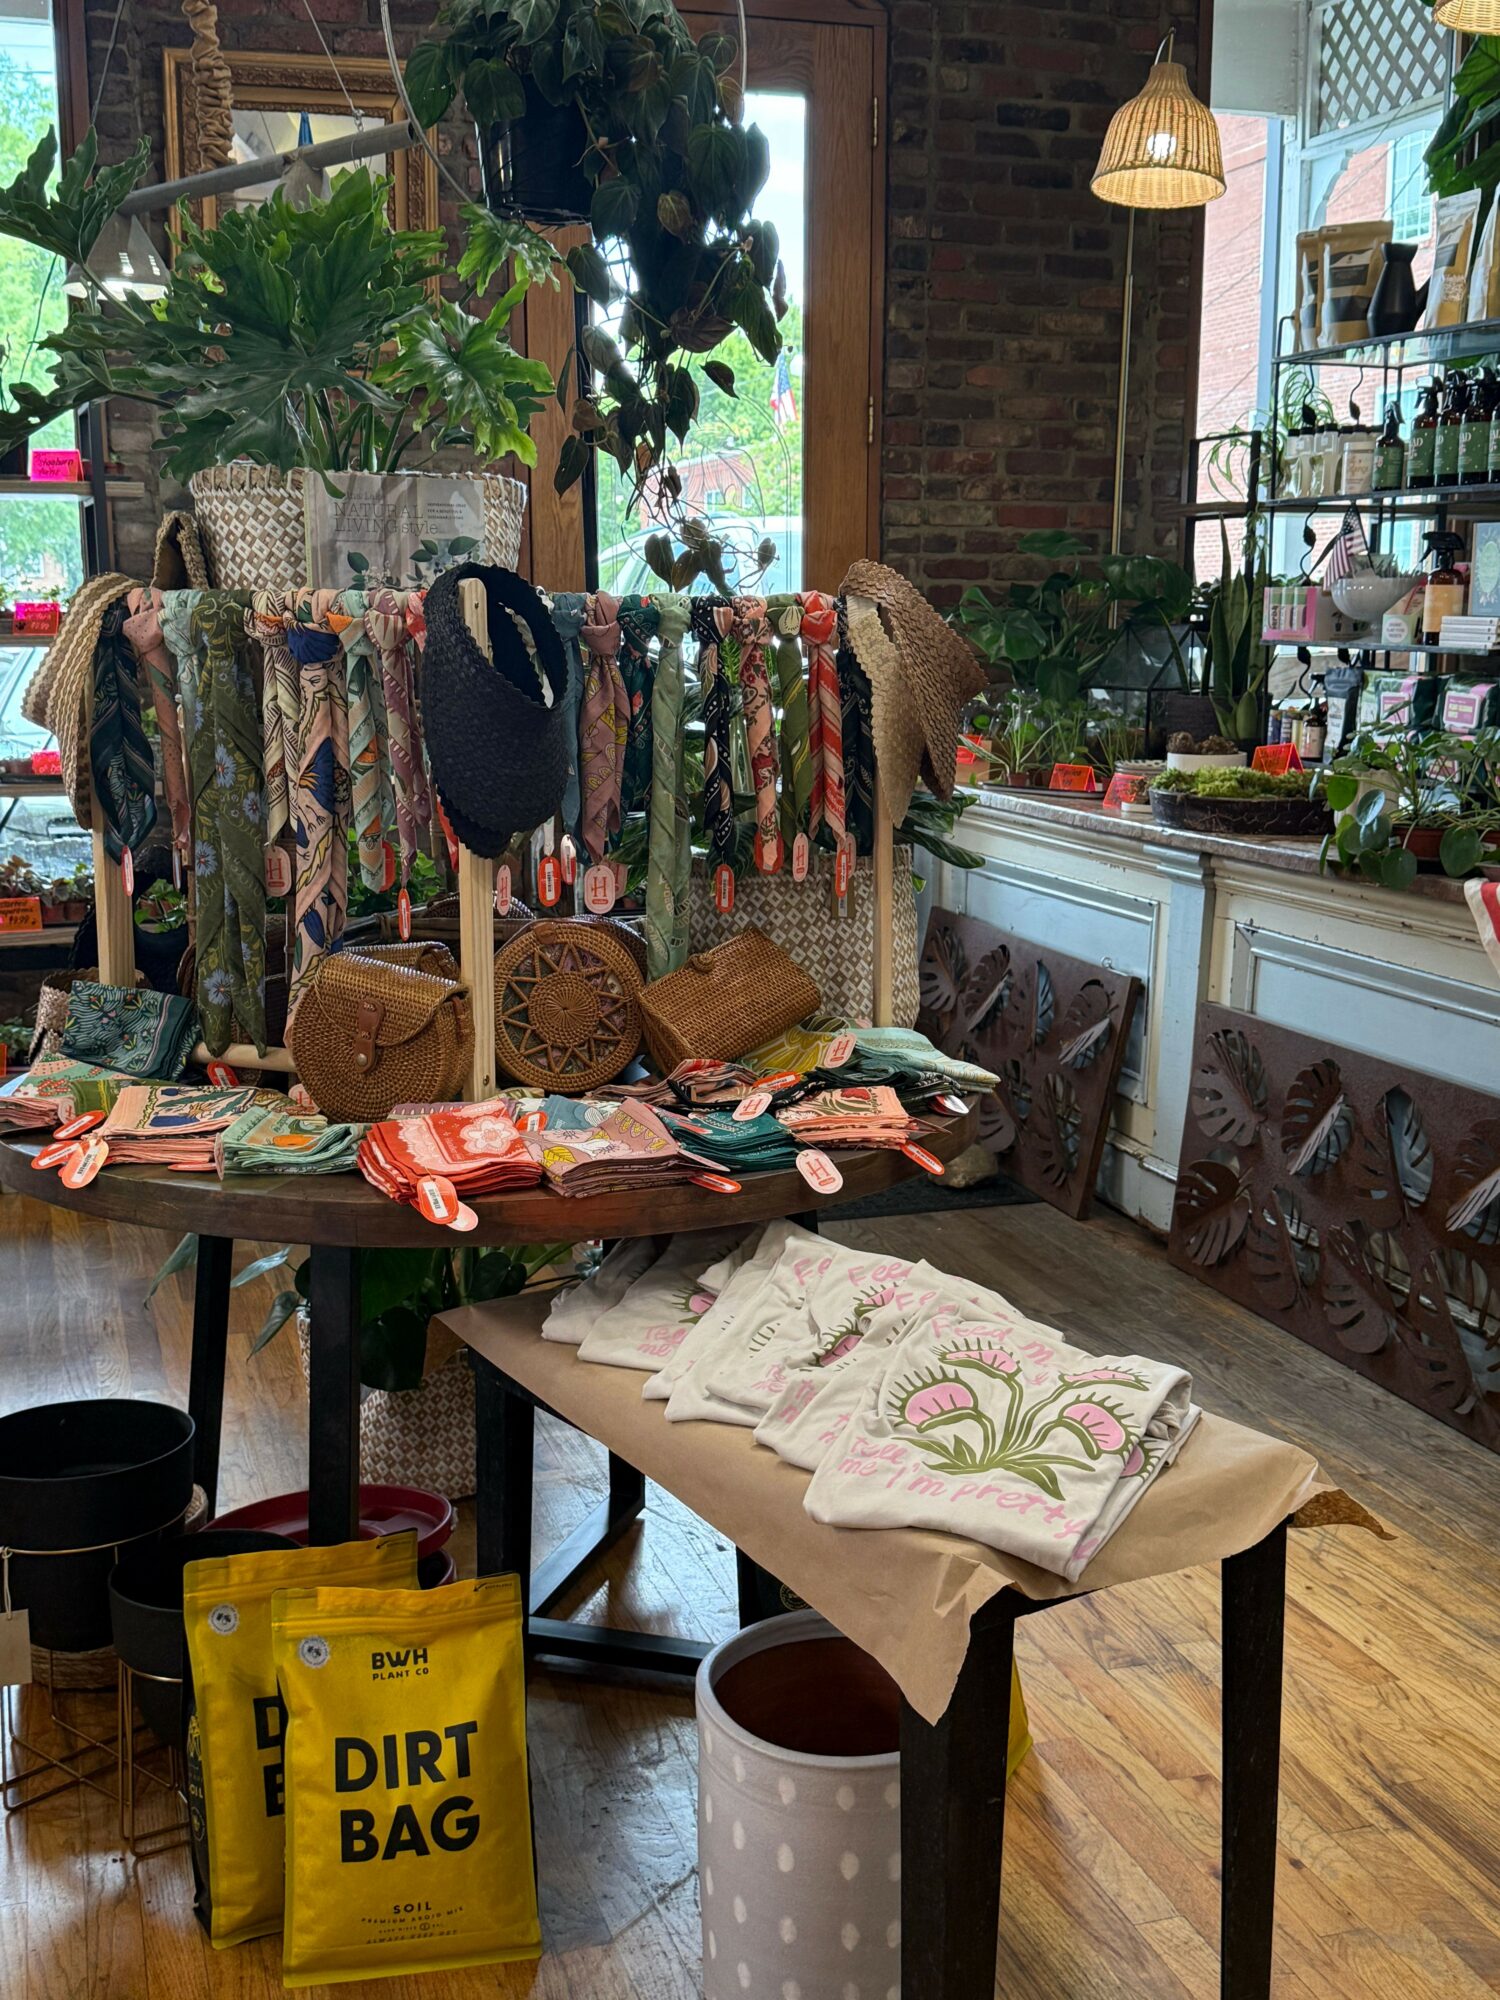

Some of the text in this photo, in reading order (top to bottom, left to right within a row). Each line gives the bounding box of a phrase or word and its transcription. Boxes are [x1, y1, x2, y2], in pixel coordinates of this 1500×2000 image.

[334, 502, 424, 518] NATURAL
[335, 518, 438, 537] LIVING style
[806, 1158, 831, 1180] H
[792, 1257, 833, 1287] Fe
[895, 1290, 937, 1311] Fe
[931, 1317, 1015, 1342] Feed
[636, 1343, 672, 1357] me
[837, 1458, 878, 1476] me
[886, 1462, 947, 1497] I'm
[371, 1648, 429, 1670] BWH
[372, 1667, 429, 1681] PLANT CO
[335, 1720, 478, 1793] DIRT
[340, 1796, 480, 1863] BAG
[393, 1901, 432, 1915] SOIL
